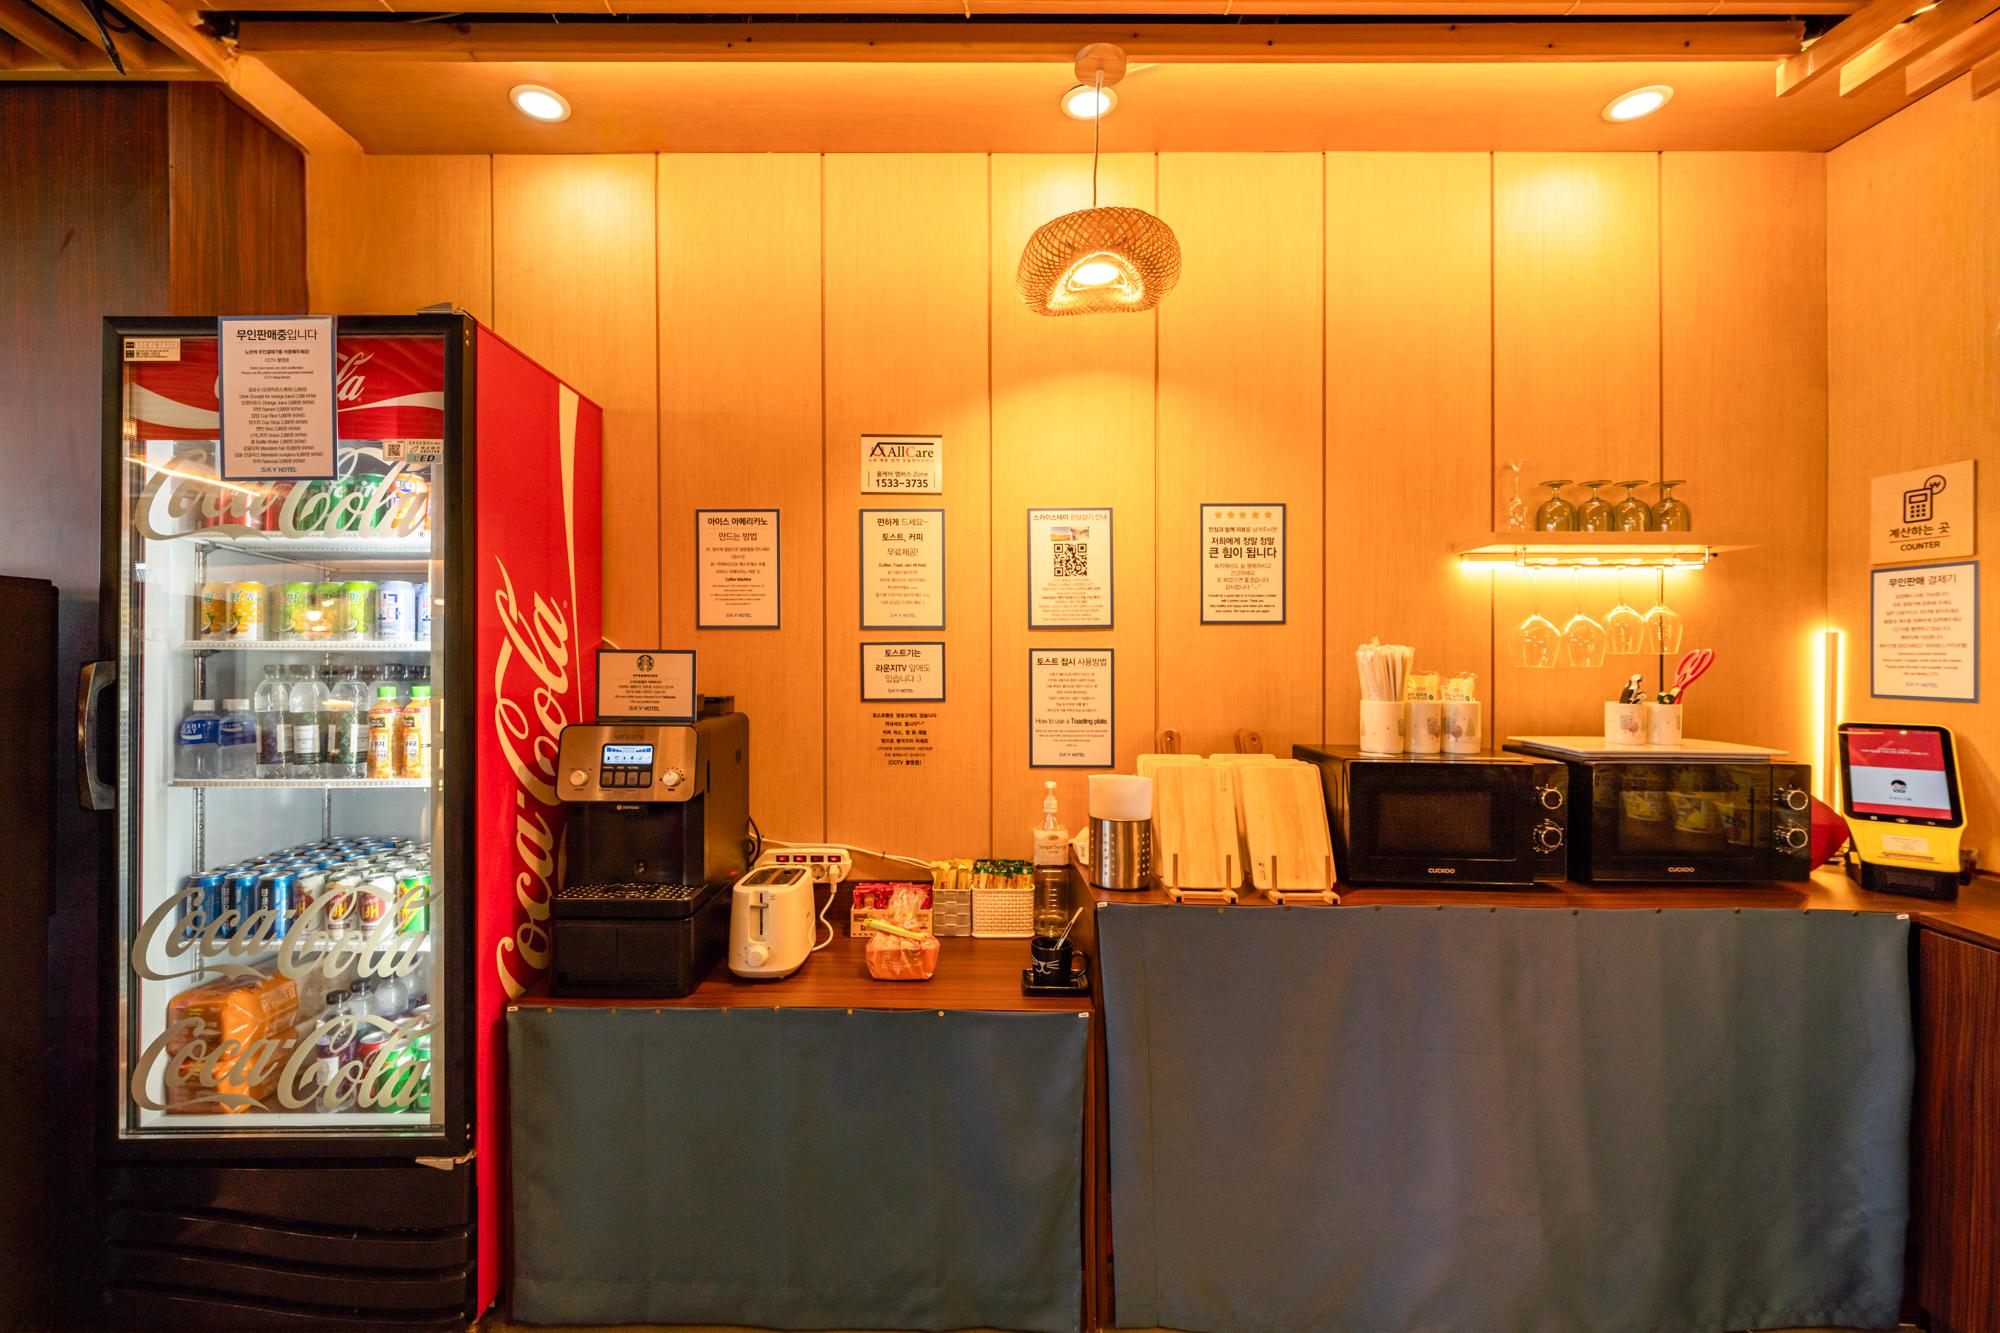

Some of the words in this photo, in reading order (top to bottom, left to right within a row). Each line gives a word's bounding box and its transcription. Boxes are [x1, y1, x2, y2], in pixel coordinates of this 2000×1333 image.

[236, 329, 318, 341] 무인판매중입니다
[888, 446, 934, 457] AllCare
[876, 479, 928, 488] 1533-3735
[135, 447, 440, 541] CocaCola
[708, 517, 730, 526] 아이스
[732, 517, 768, 526] 아메리카노
[877, 518, 899, 526] 편하게
[1889, 525, 1934, 538] 계산하는
[1938, 522, 1950, 534] 곳
[719, 532, 740, 541] 만드는
[743, 532, 757, 541] 방법
[908, 533, 923, 541] 커피
[1212, 537, 1240, 545] 저희에게
[1244, 537, 1257, 545] 정말
[1260, 537, 1274, 545] 정말
[1900, 541, 1940, 551] COUNTER
[1209, 547, 1219, 558] 큰
[1223, 547, 1242, 558] 힘이
[1246, 547, 1277, 558] 됩니다
[1889, 576, 1925, 588] 무인판매
[1928, 574, 1956, 585] 결제기
[885, 649, 922, 657] 토스트기는
[1061, 658, 1076, 666] 접시
[1077, 658, 1107, 666] 사용방법
[876, 664, 907, 673] 라운지TV
[908, 664, 931, 673] 앞에도
[885, 674, 914, 683] 있습니다
[132, 886, 443, 981] Coca-Cola
[132, 1015, 443, 1111] Coca-Cola
